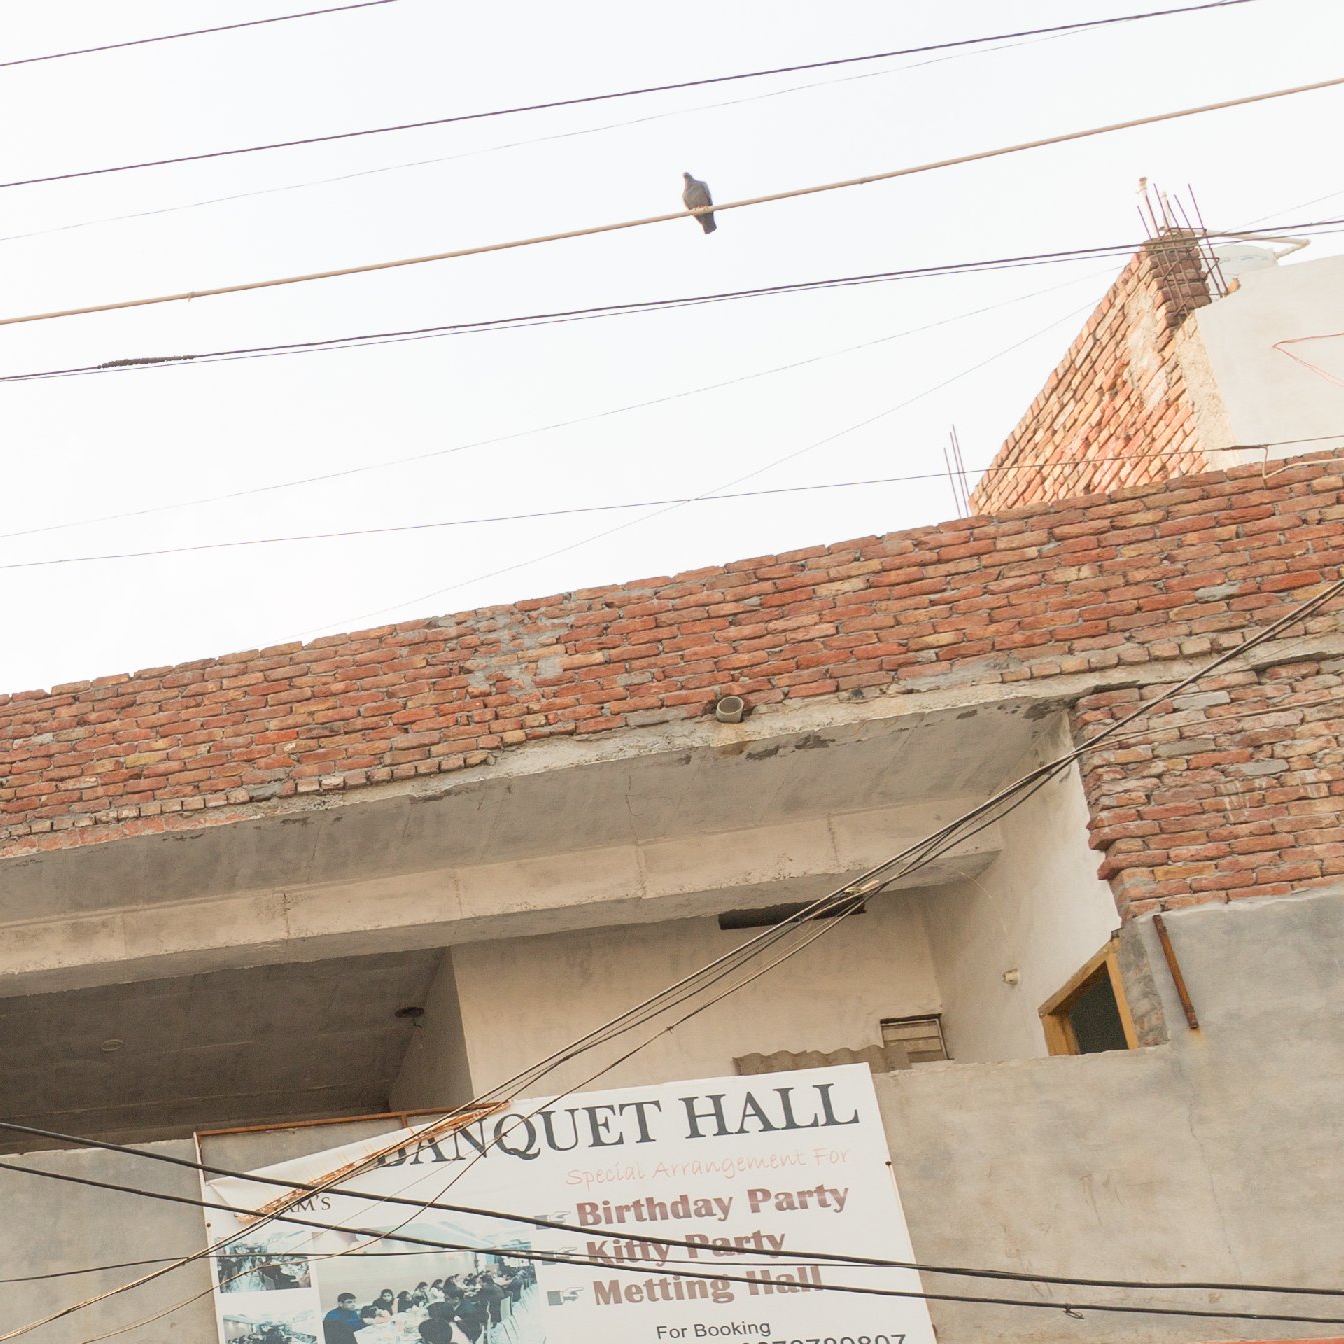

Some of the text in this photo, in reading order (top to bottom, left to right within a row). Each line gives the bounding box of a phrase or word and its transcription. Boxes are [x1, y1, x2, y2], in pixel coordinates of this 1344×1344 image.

[678, 1083, 860, 1139] HALL
[565, 1148, 851, 1190] Special Arrangement For
[576, 1185, 849, 1227] Birthday Party
[587, 1230, 786, 1268] Kitty Party
[593, 1264, 823, 1305] Metting Hall
[656, 1321, 772, 1340] For Booking
